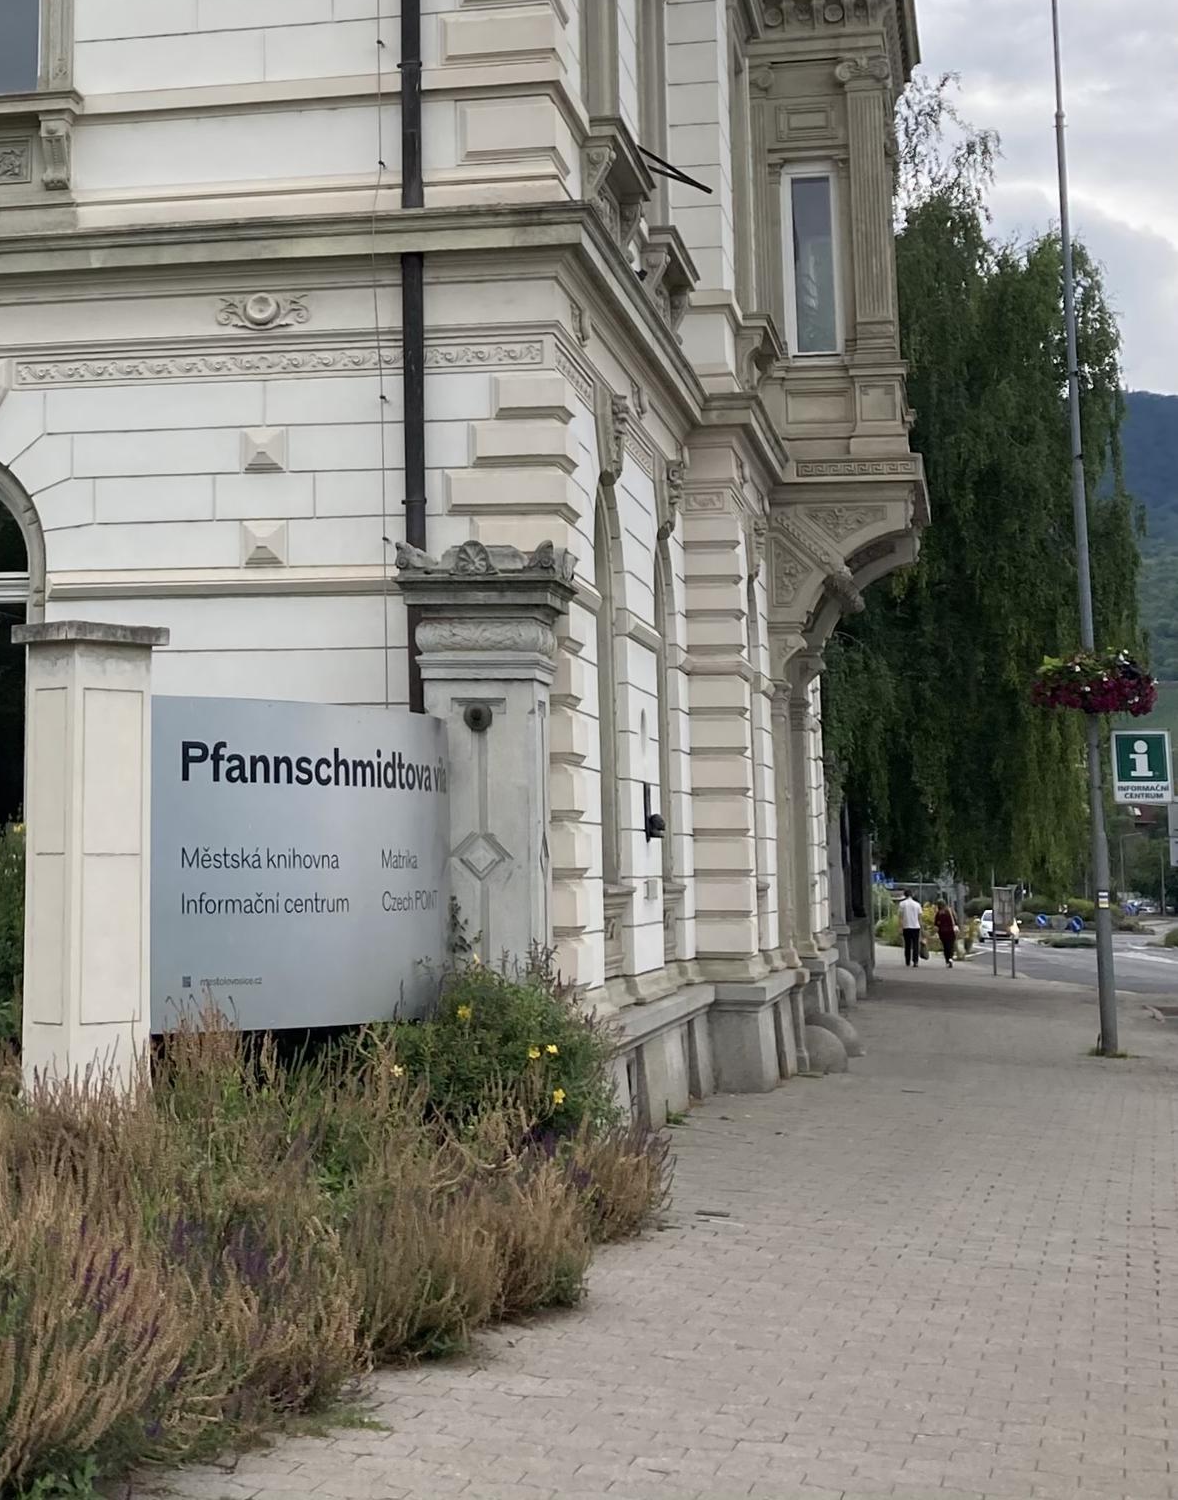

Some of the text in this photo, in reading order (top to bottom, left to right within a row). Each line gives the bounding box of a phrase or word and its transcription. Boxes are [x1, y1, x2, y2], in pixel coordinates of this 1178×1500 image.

[181, 740, 432, 792] Pfannschmidtova
[1117, 784, 1170, 792] INFORMAČNÍ
[181, 847, 340, 869] Městská knihovna
[381, 848, 419, 869] Matrika
[181, 891, 350, 915] Informační centrum
[382, 890, 414, 912] Czech
